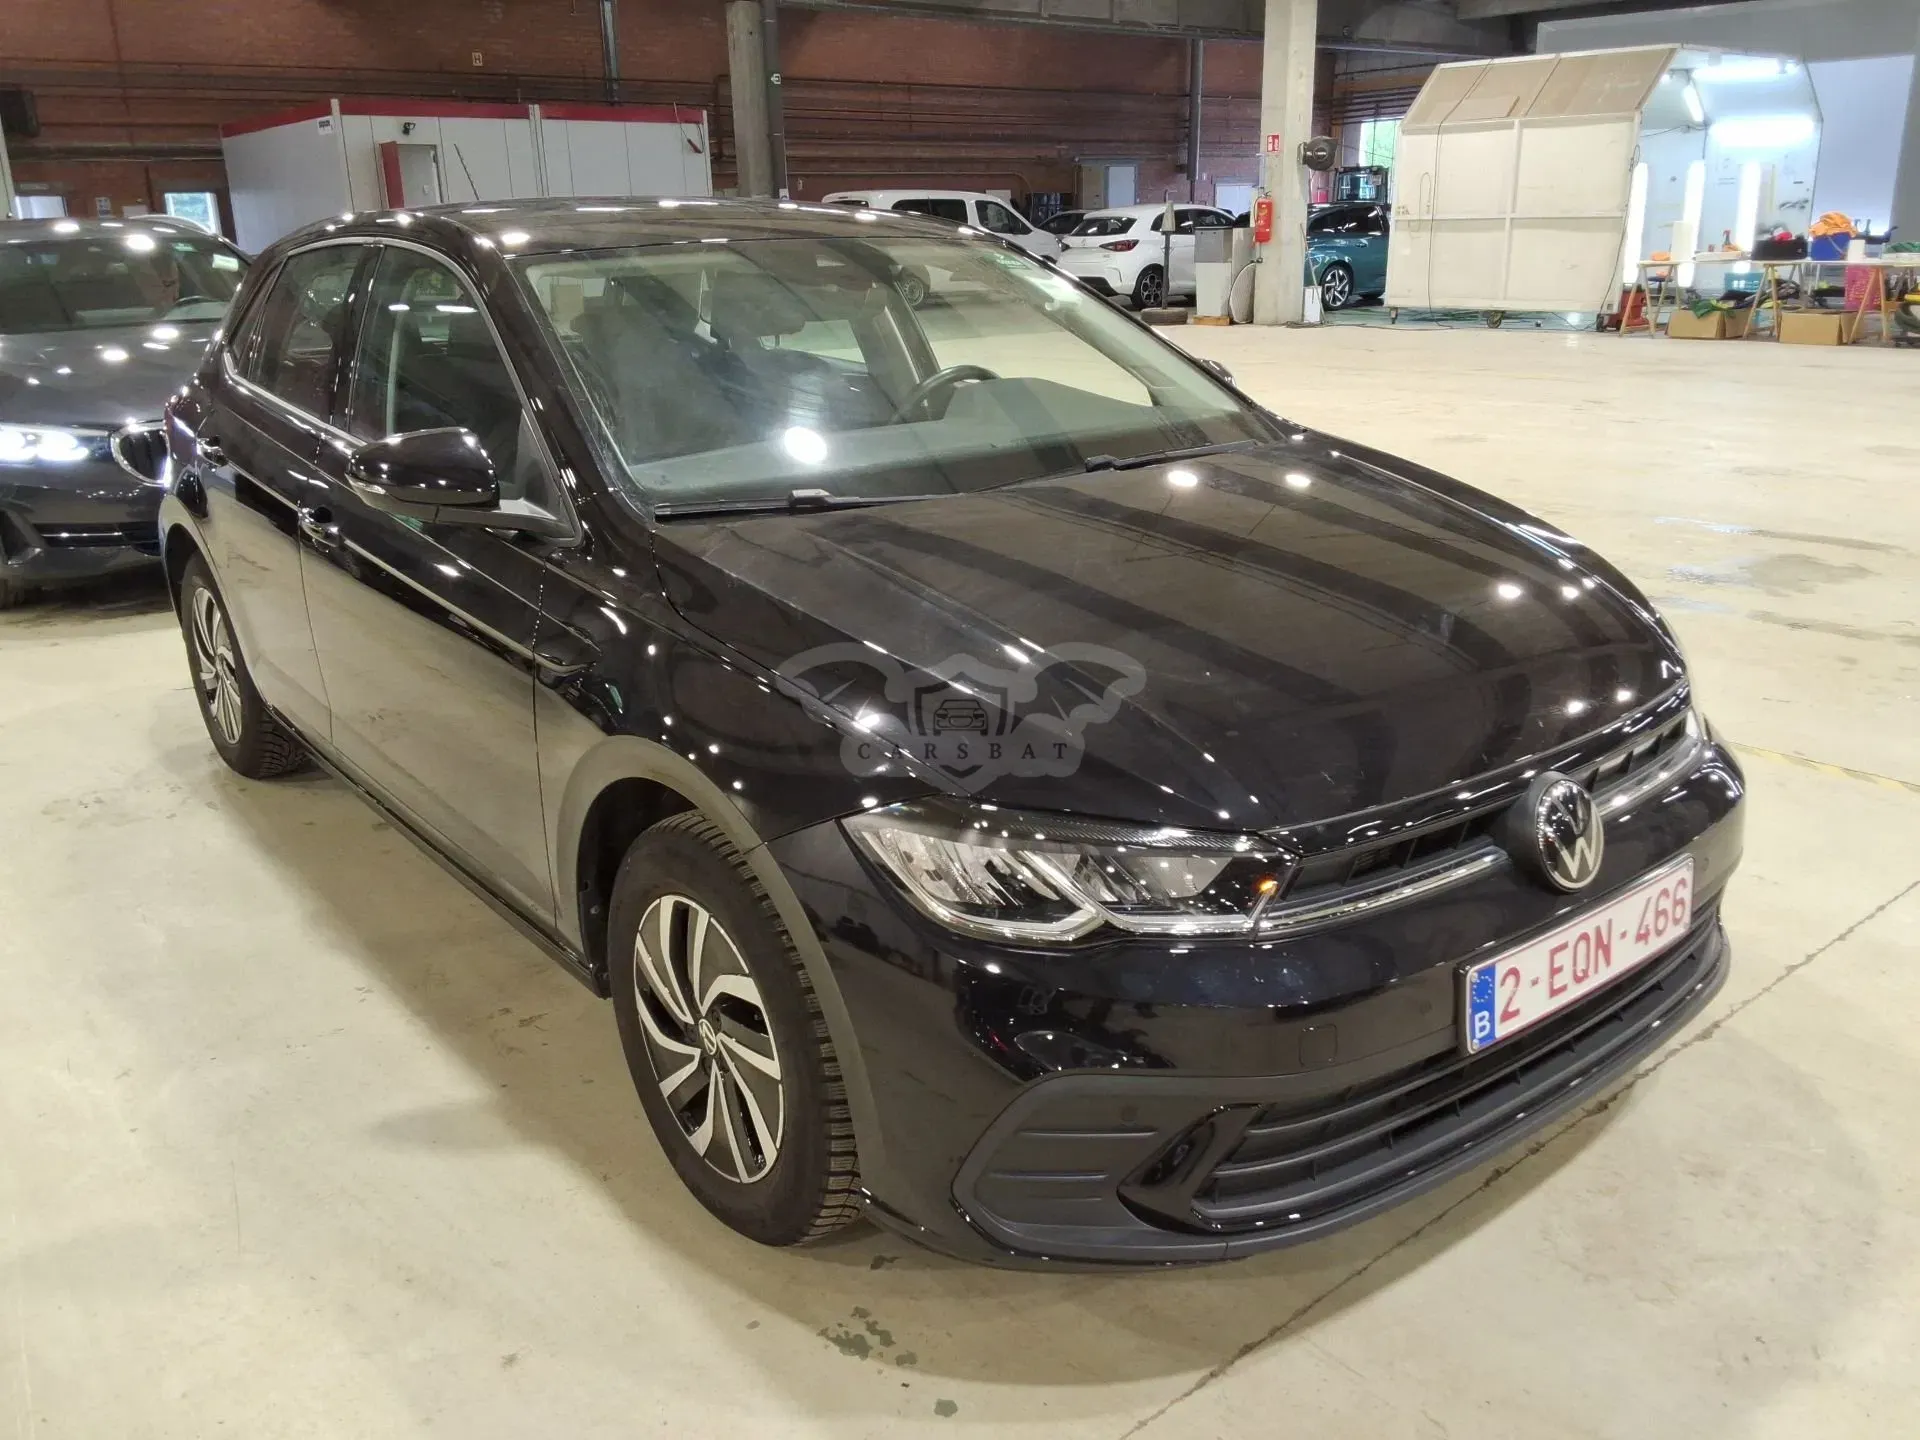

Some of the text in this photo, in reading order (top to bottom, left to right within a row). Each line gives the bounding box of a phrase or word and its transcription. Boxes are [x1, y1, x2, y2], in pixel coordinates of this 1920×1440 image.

[1541, 782, 1603, 889] VW
[1500, 877, 1688, 1024] 2-EQN-466
[1475, 1011, 1491, 1038] B
